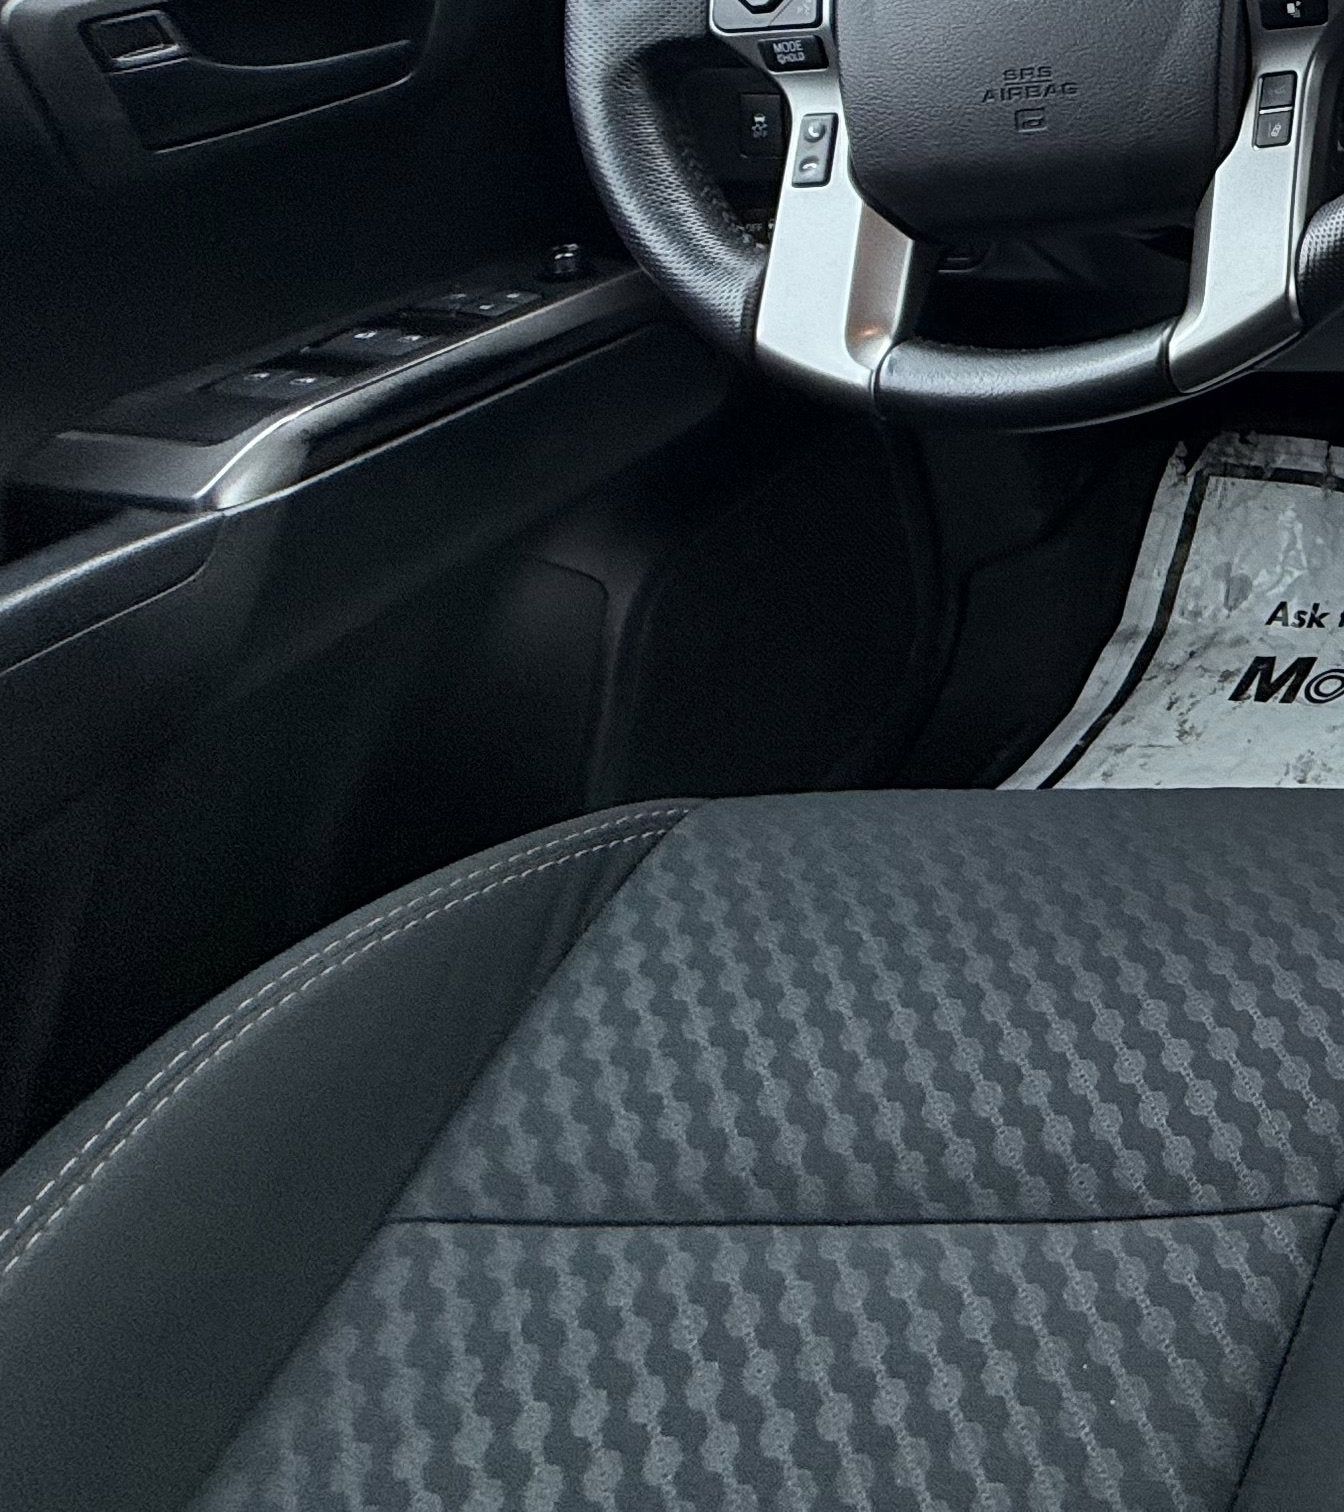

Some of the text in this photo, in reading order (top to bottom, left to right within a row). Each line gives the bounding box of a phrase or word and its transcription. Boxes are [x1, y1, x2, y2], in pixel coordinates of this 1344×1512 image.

[773, 40, 802, 53] MODE
[1003, 66, 1053, 82] SRS
[982, 82, 1078, 103] AIRBAG
[1265, 601, 1330, 628] Ask
